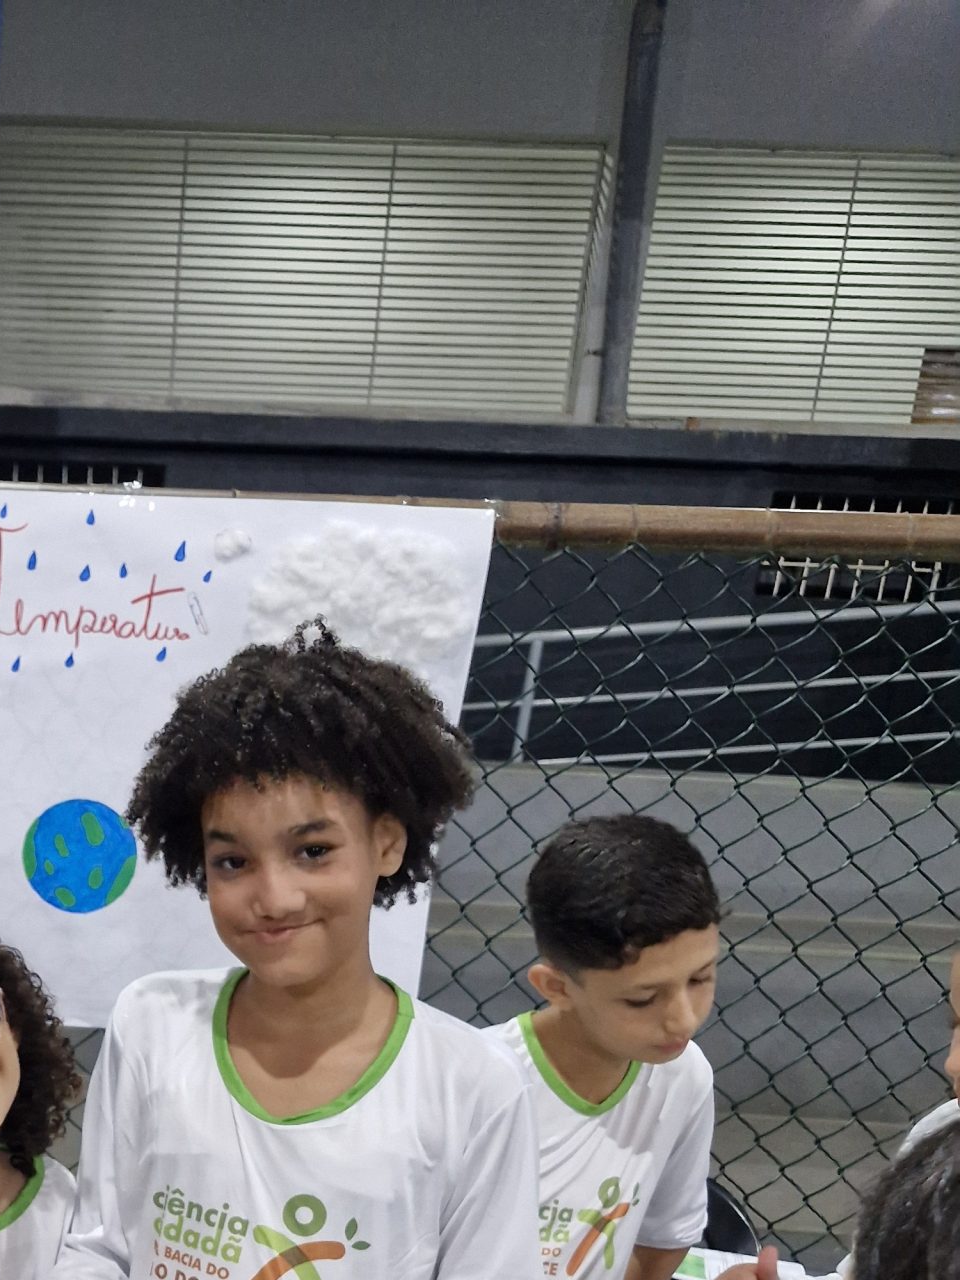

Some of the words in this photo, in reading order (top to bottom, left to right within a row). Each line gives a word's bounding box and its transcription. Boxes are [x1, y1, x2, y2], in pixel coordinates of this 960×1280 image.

[153, 1213, 242, 1264] cdadã
[163, 1245, 202, 1272] BACIA
[205, 1261, 230, 1280] DO
